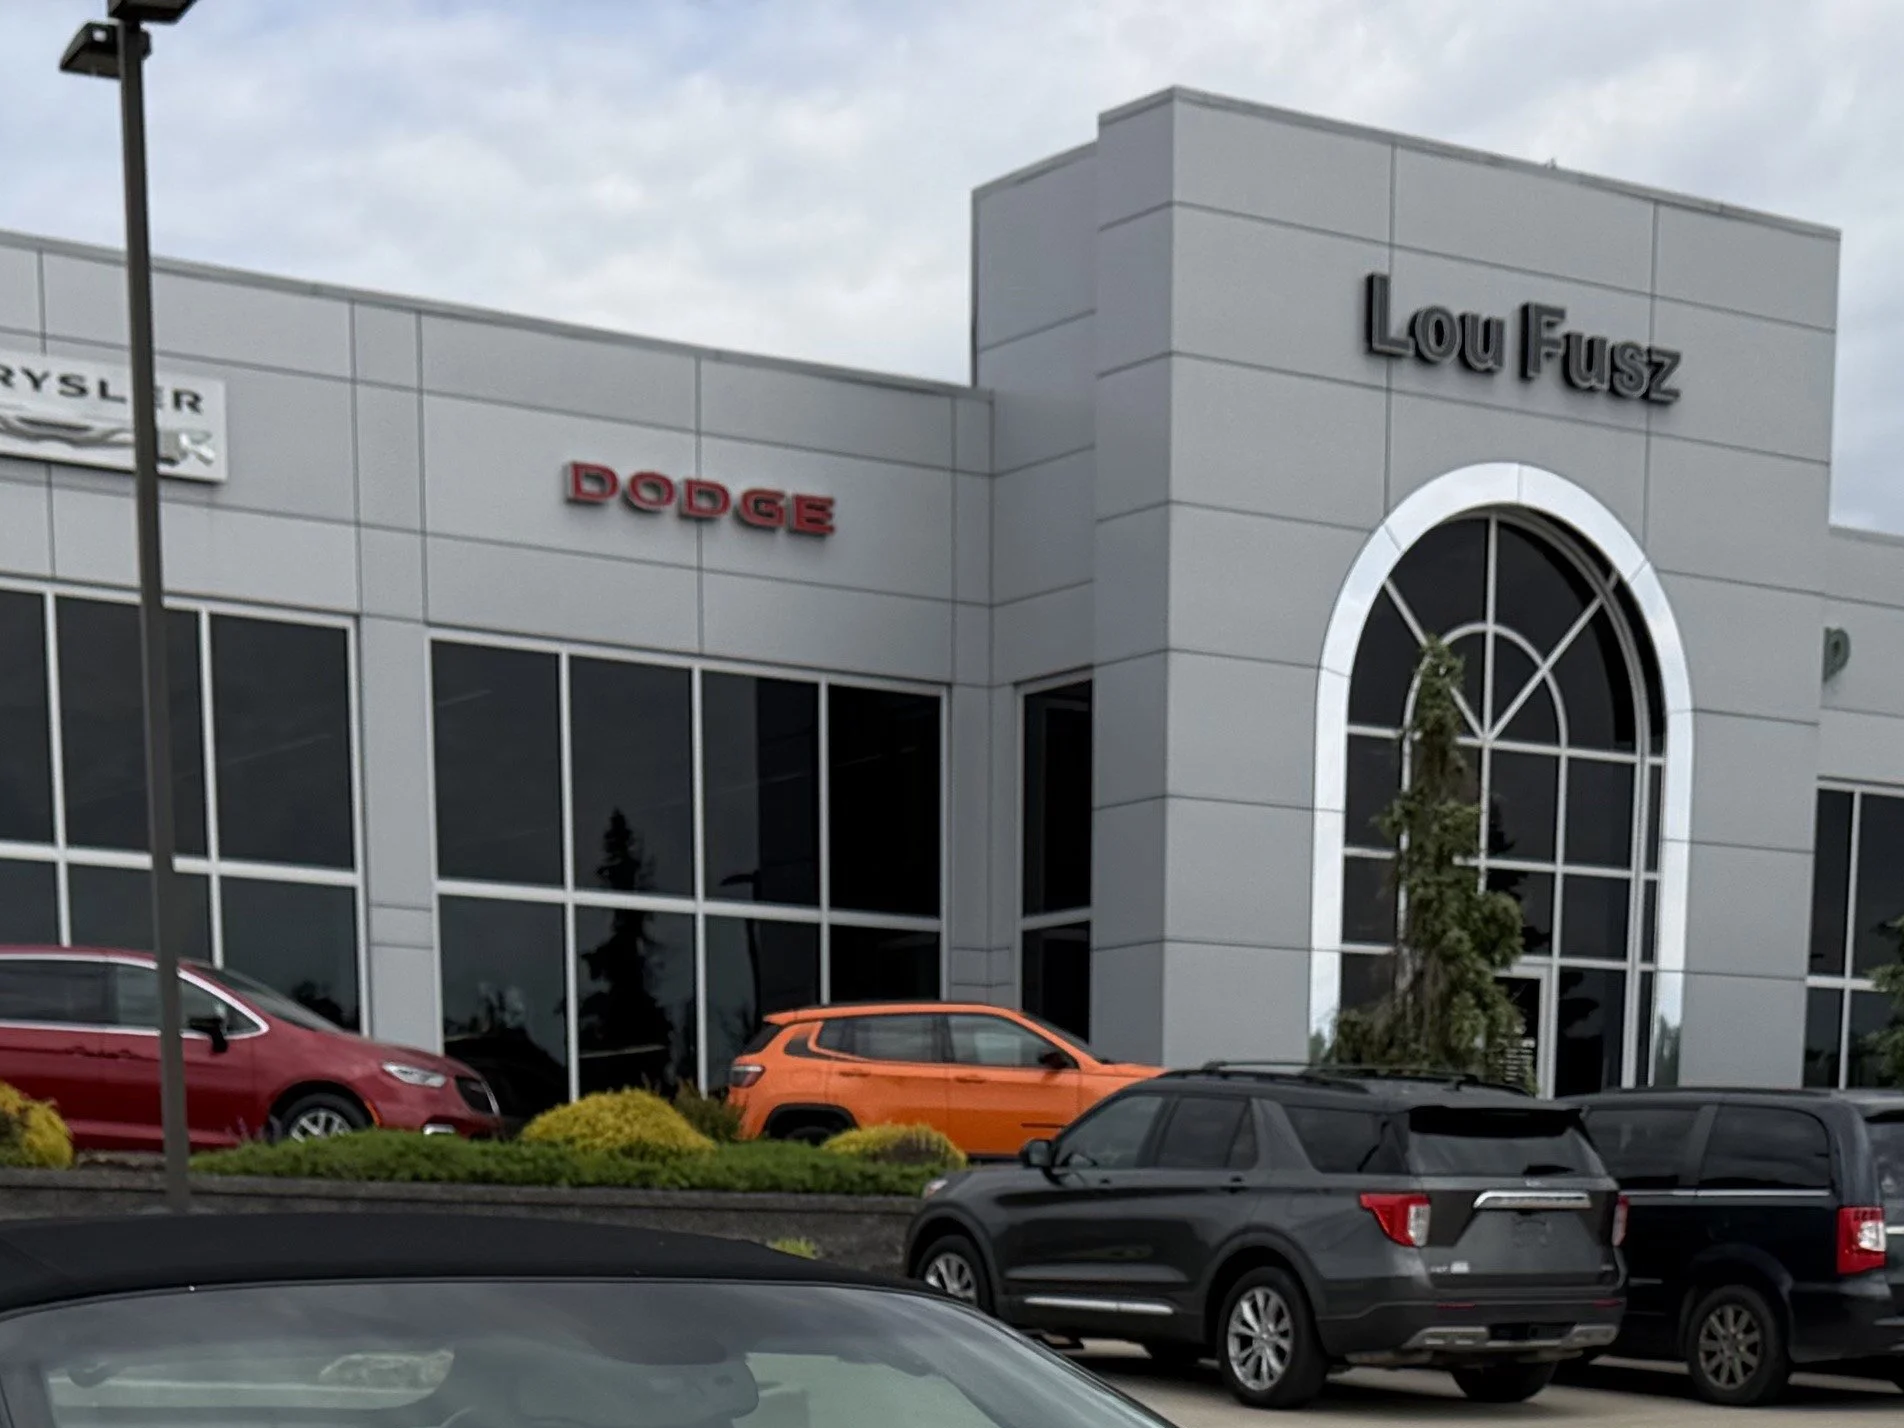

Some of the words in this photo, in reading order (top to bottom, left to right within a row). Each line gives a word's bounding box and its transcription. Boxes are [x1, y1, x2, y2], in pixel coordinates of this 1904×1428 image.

[1365, 272, 1504, 372] Lou
[1519, 301, 1682, 402] Fusz
[565, 461, 836, 535] DODGE
